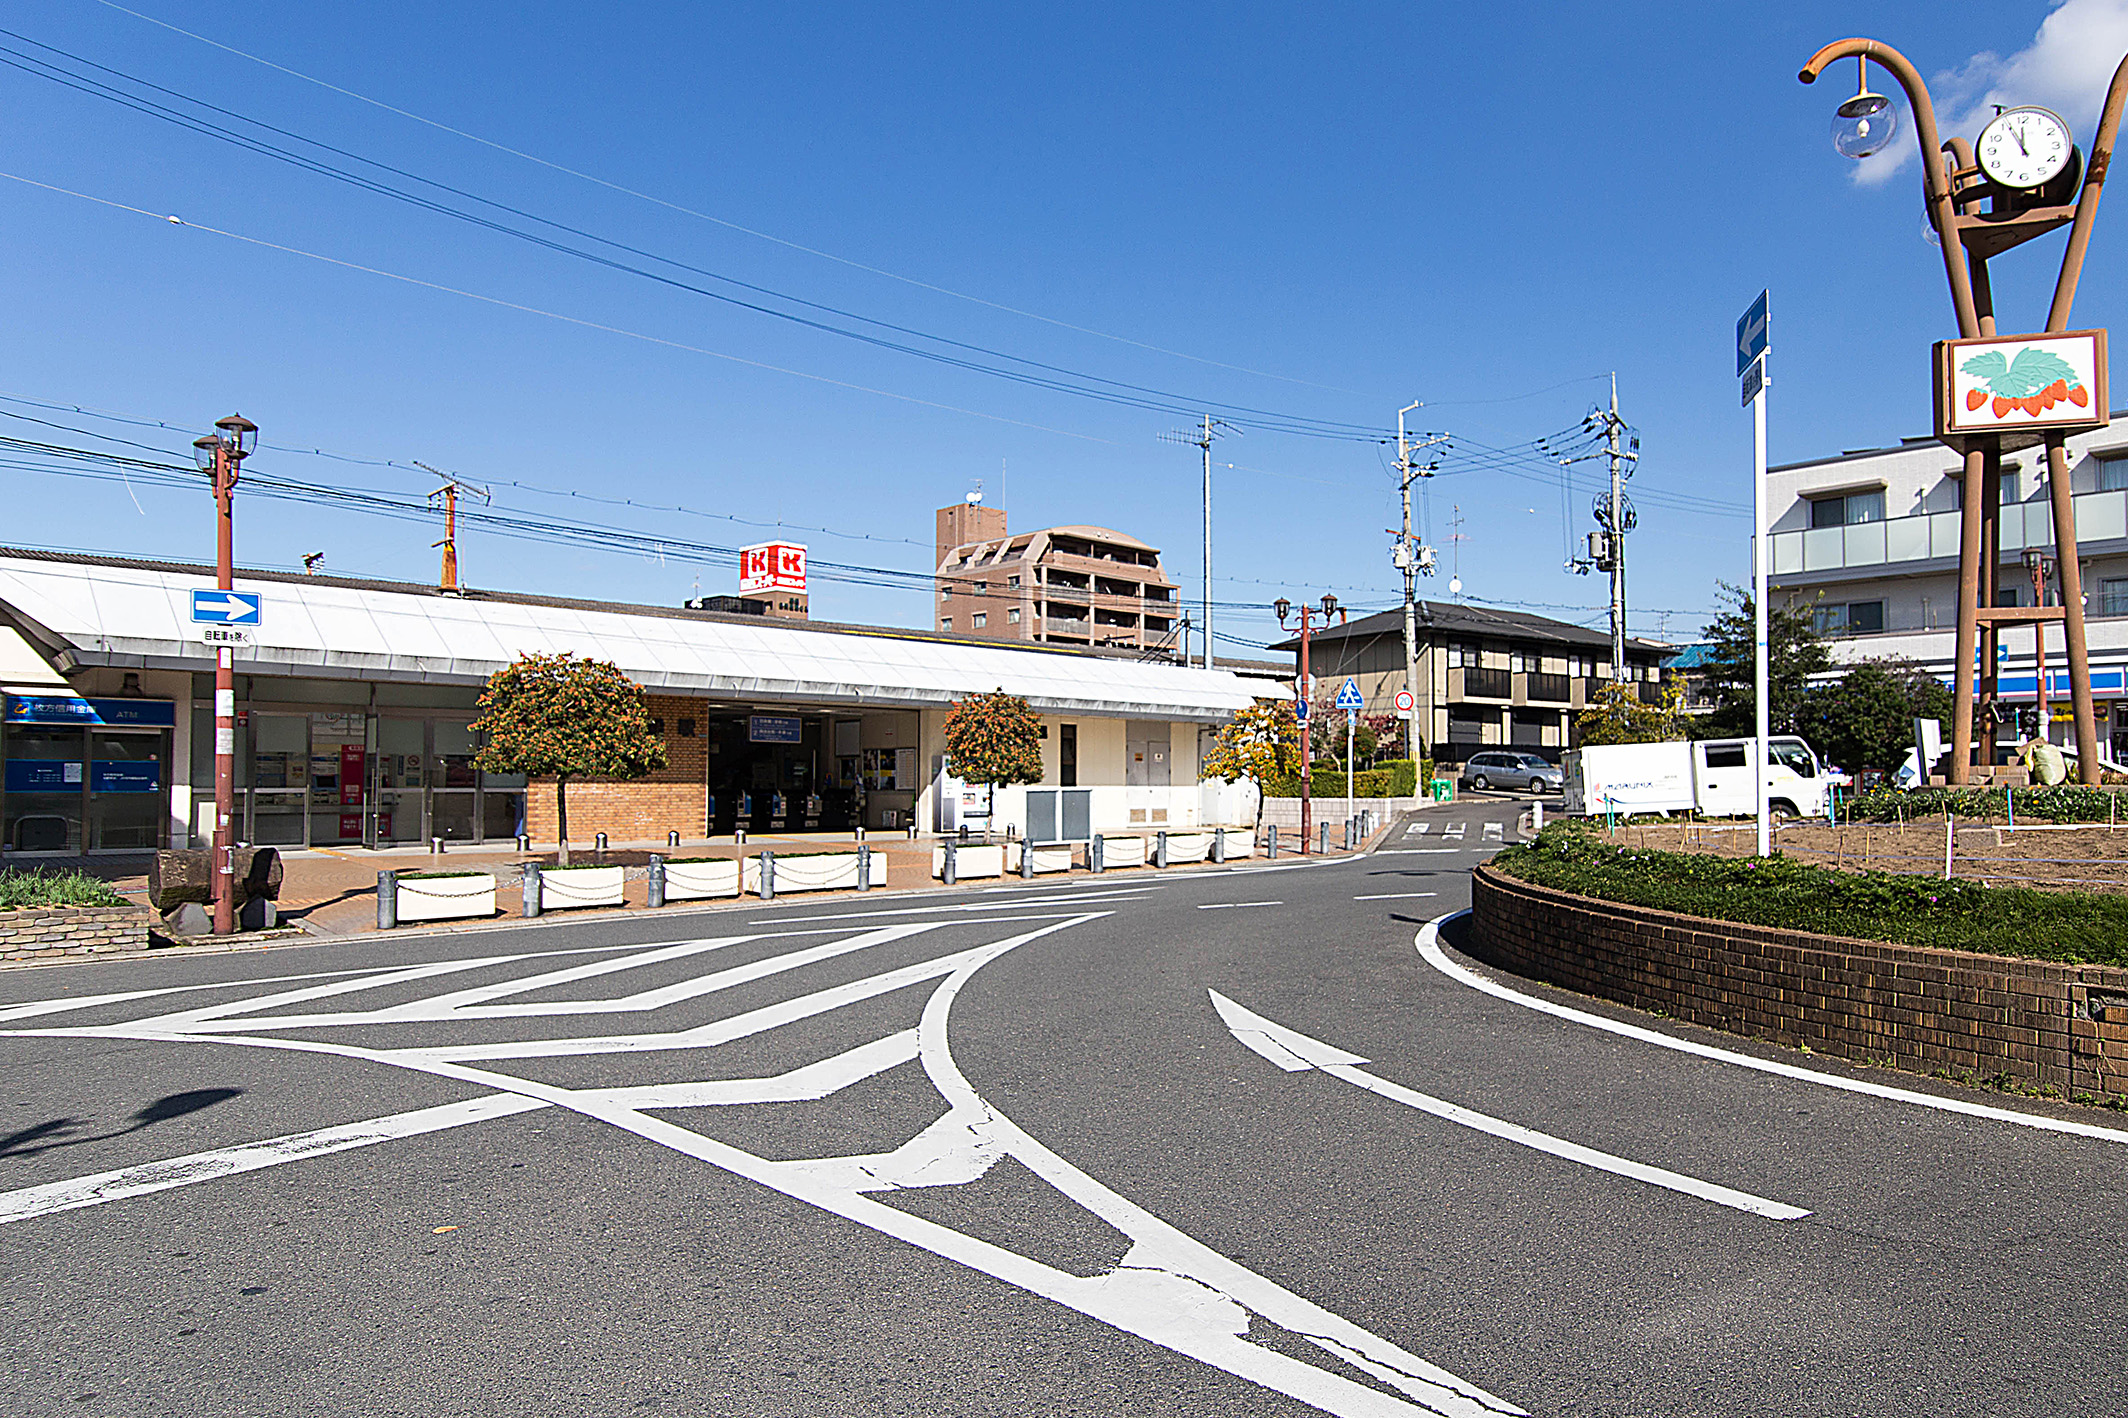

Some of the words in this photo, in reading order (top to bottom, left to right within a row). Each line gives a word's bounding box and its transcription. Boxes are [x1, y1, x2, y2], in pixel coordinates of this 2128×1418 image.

[2017, 115, 2029, 124] 12
[2047, 127, 2055, 136] 2
[1990, 134, 2002, 143] 10
[2051, 141, 2060, 150] 3
[1987, 147, 1997, 155] 9
[1991, 160, 2001, 168] 8
[2004, 170, 2013, 178] 7
[2037, 167, 2047, 175] 5
[2019, 173, 2029, 181] 6
[751, 551, 766, 573] K
[782, 551, 802, 573] K
[1399, 696, 1410, 706] 20
[115, 711, 139, 719] ATM
